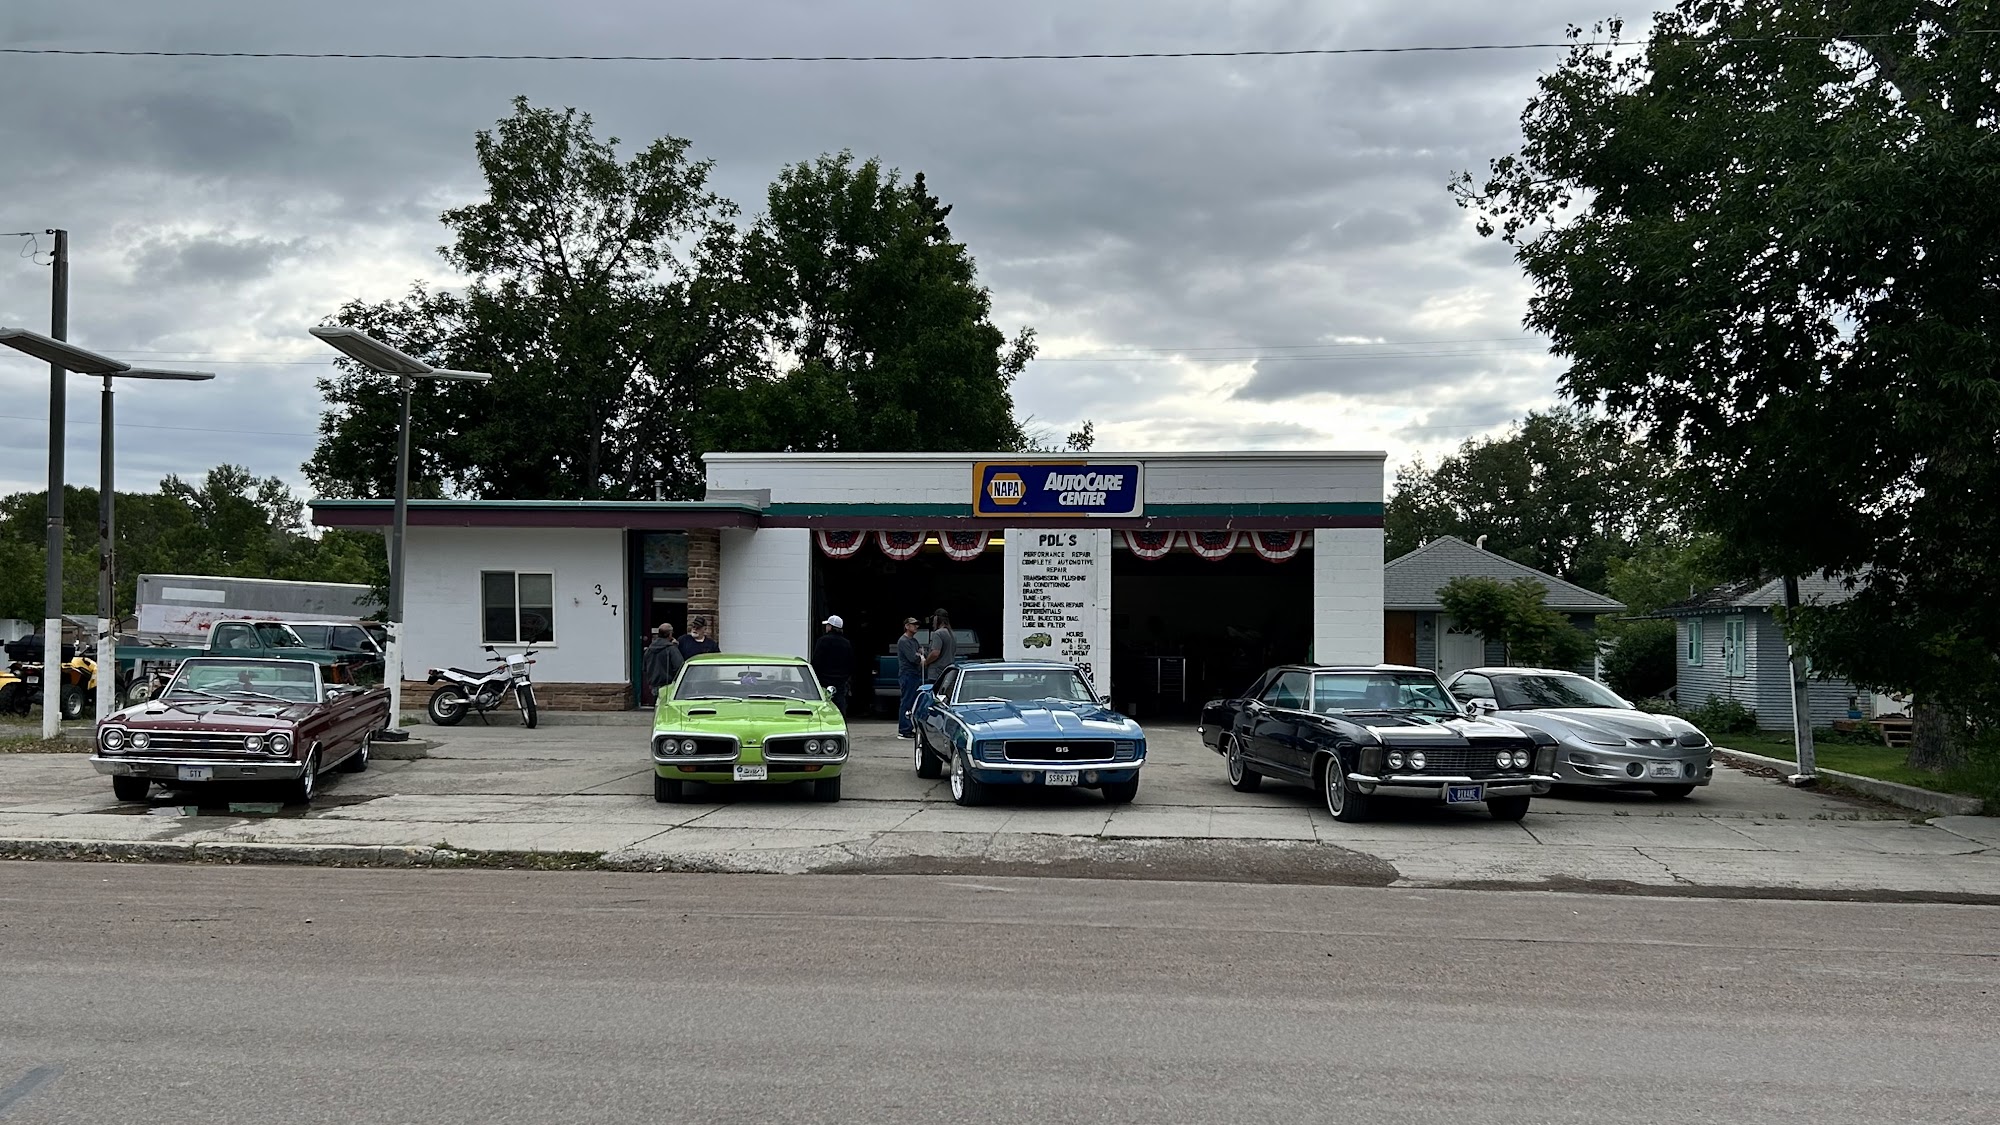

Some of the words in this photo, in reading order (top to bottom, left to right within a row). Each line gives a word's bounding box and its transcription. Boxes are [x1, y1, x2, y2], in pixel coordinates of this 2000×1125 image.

[994, 481, 1020, 497] NAPA
[1058, 492, 1107, 506] CENTER
[1039, 533, 1077, 547] PDL'S
[189, 770, 202, 778] GTX
